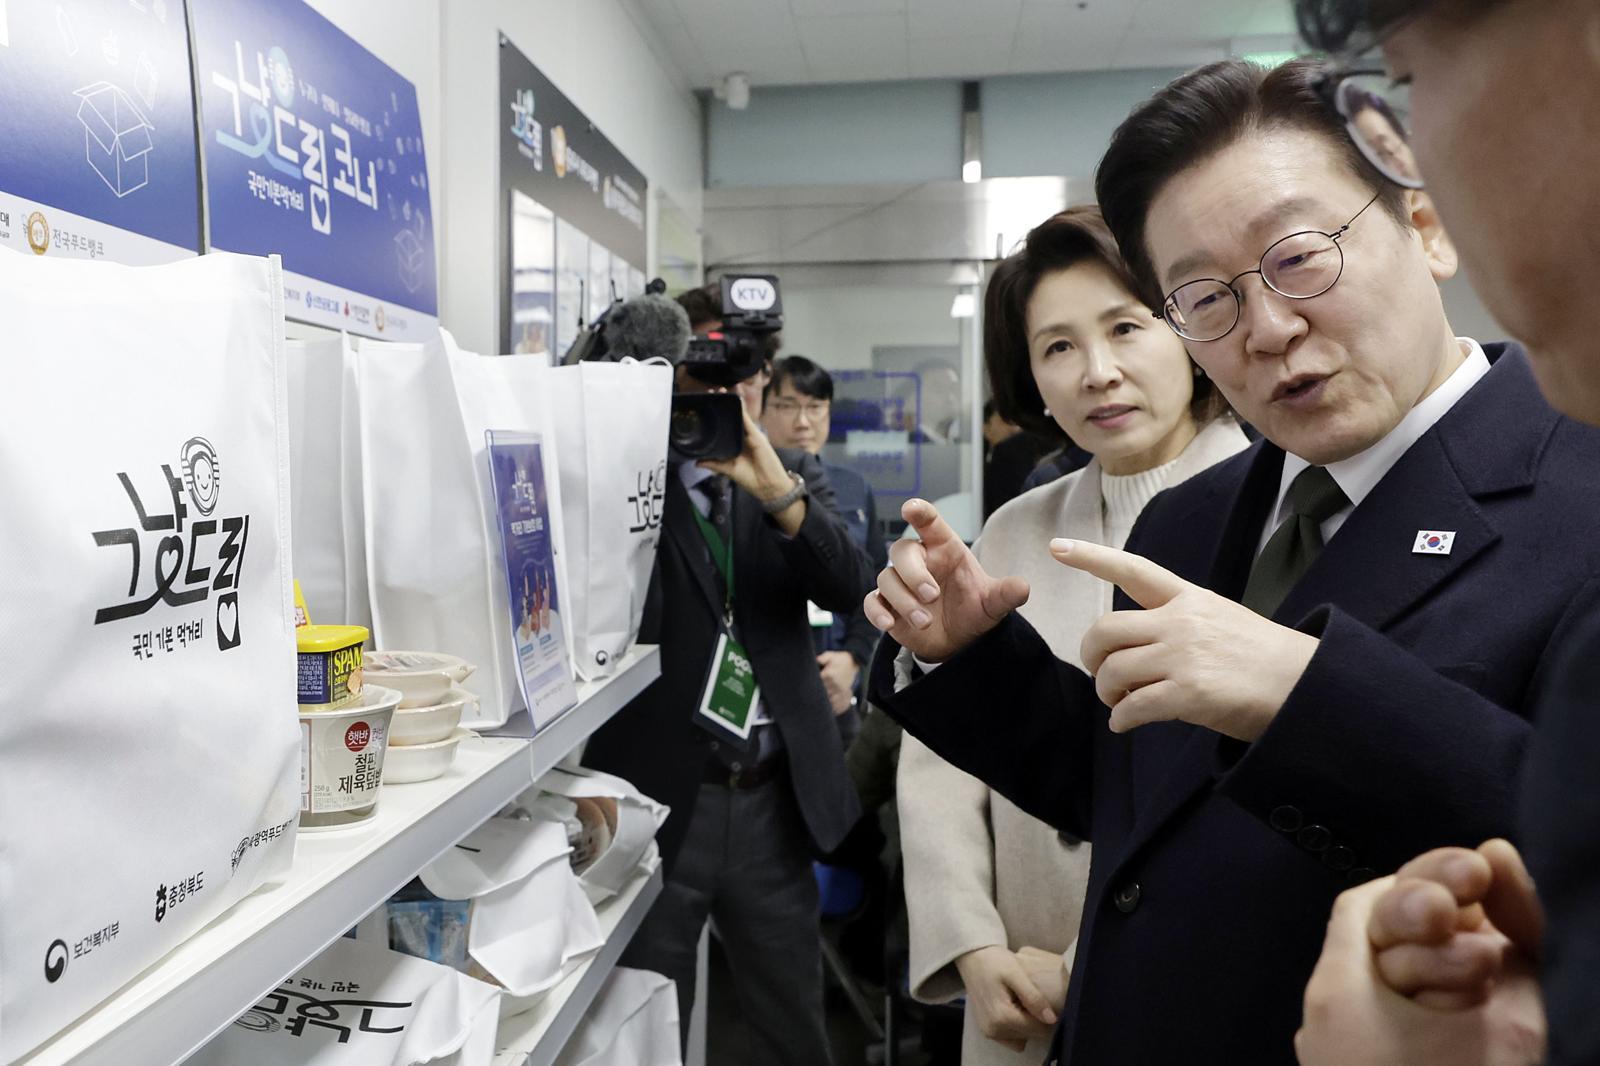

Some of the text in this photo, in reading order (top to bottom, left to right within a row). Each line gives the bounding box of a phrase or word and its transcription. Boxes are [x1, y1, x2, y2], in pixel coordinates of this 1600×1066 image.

[330, 122, 379, 211] 코너
[53, 228, 105, 259] 전국푸드뱅크
[738, 287, 768, 301] KTV
[132, 618, 204, 661] 국민 기본 먹거리
[333, 645, 364, 677] SPAM
[347, 729, 369, 747] 햇반
[354, 752, 376, 774] 철판
[168, 870, 205, 909] 충청북도
[73, 920, 120, 960] 보건복지부
